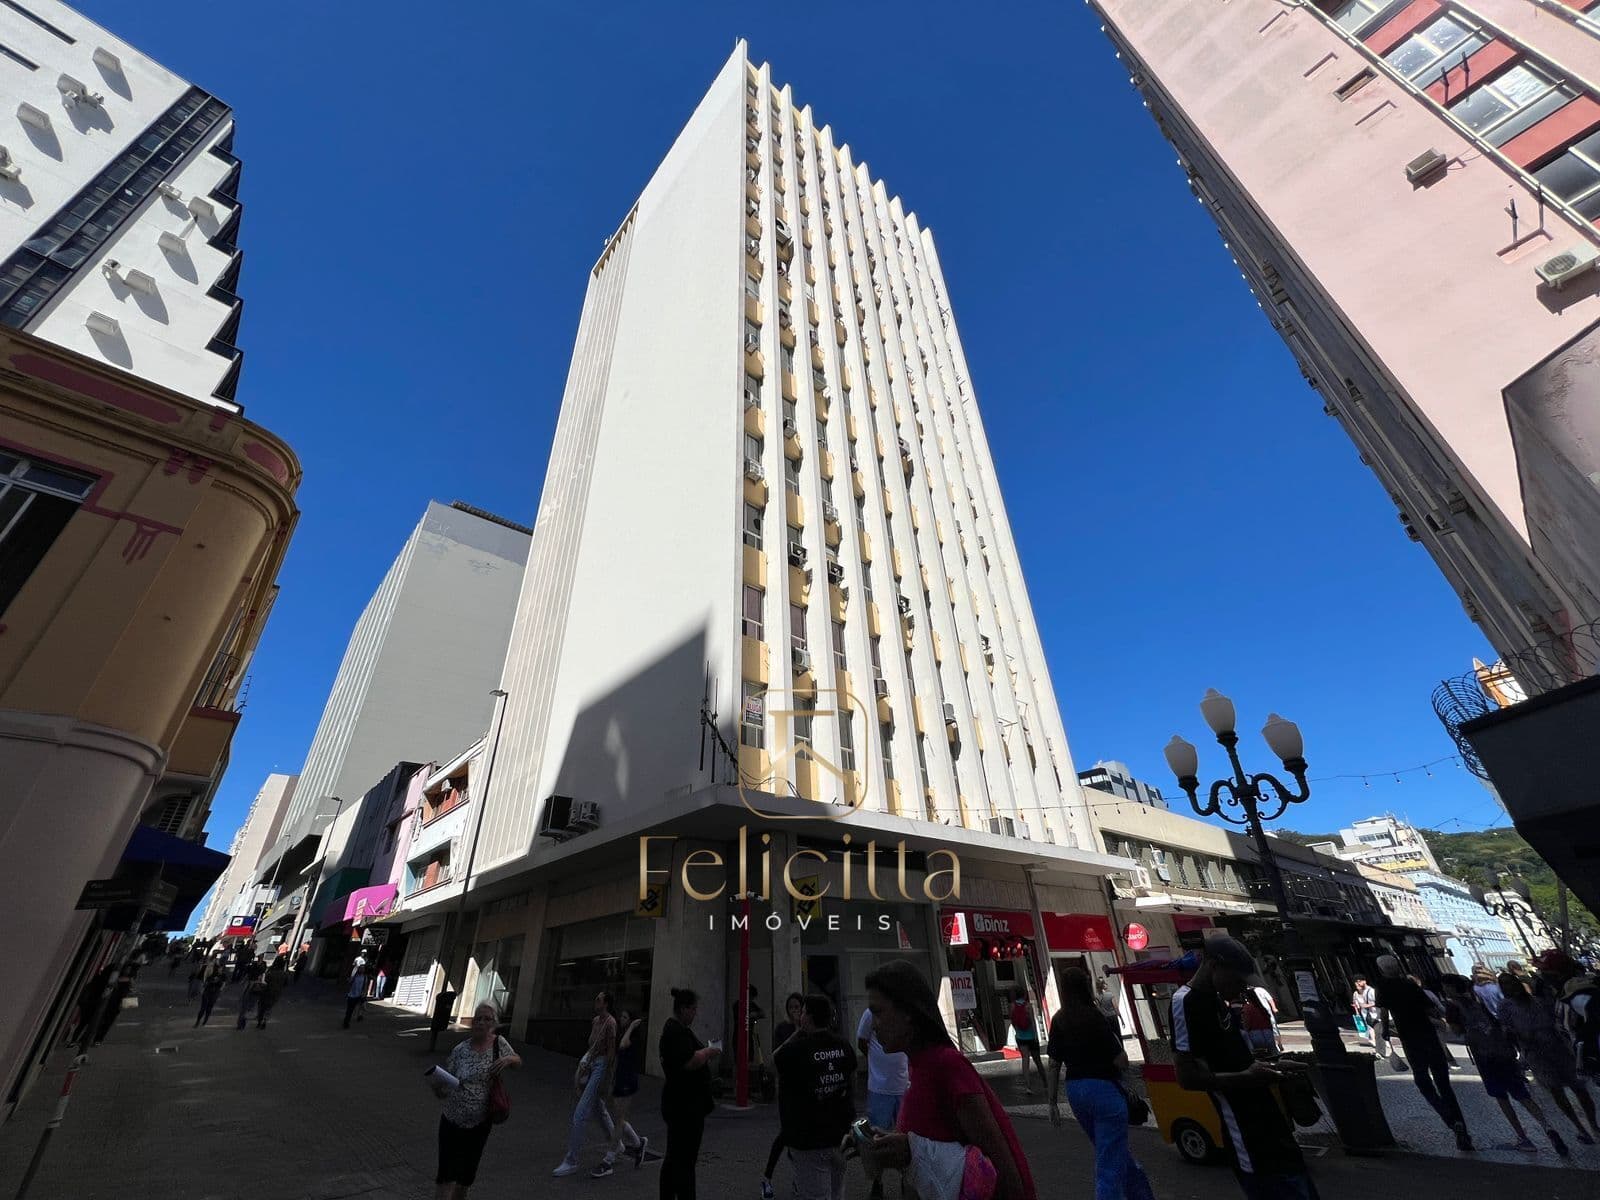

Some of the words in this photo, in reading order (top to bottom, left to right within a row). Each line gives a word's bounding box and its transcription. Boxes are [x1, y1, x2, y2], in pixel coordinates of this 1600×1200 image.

[984, 918, 1010, 932] DINIZ
[813, 1049, 845, 1061] COMPRA
[828, 1062, 834, 1071] &
[819, 1072, 845, 1084] VENDA
